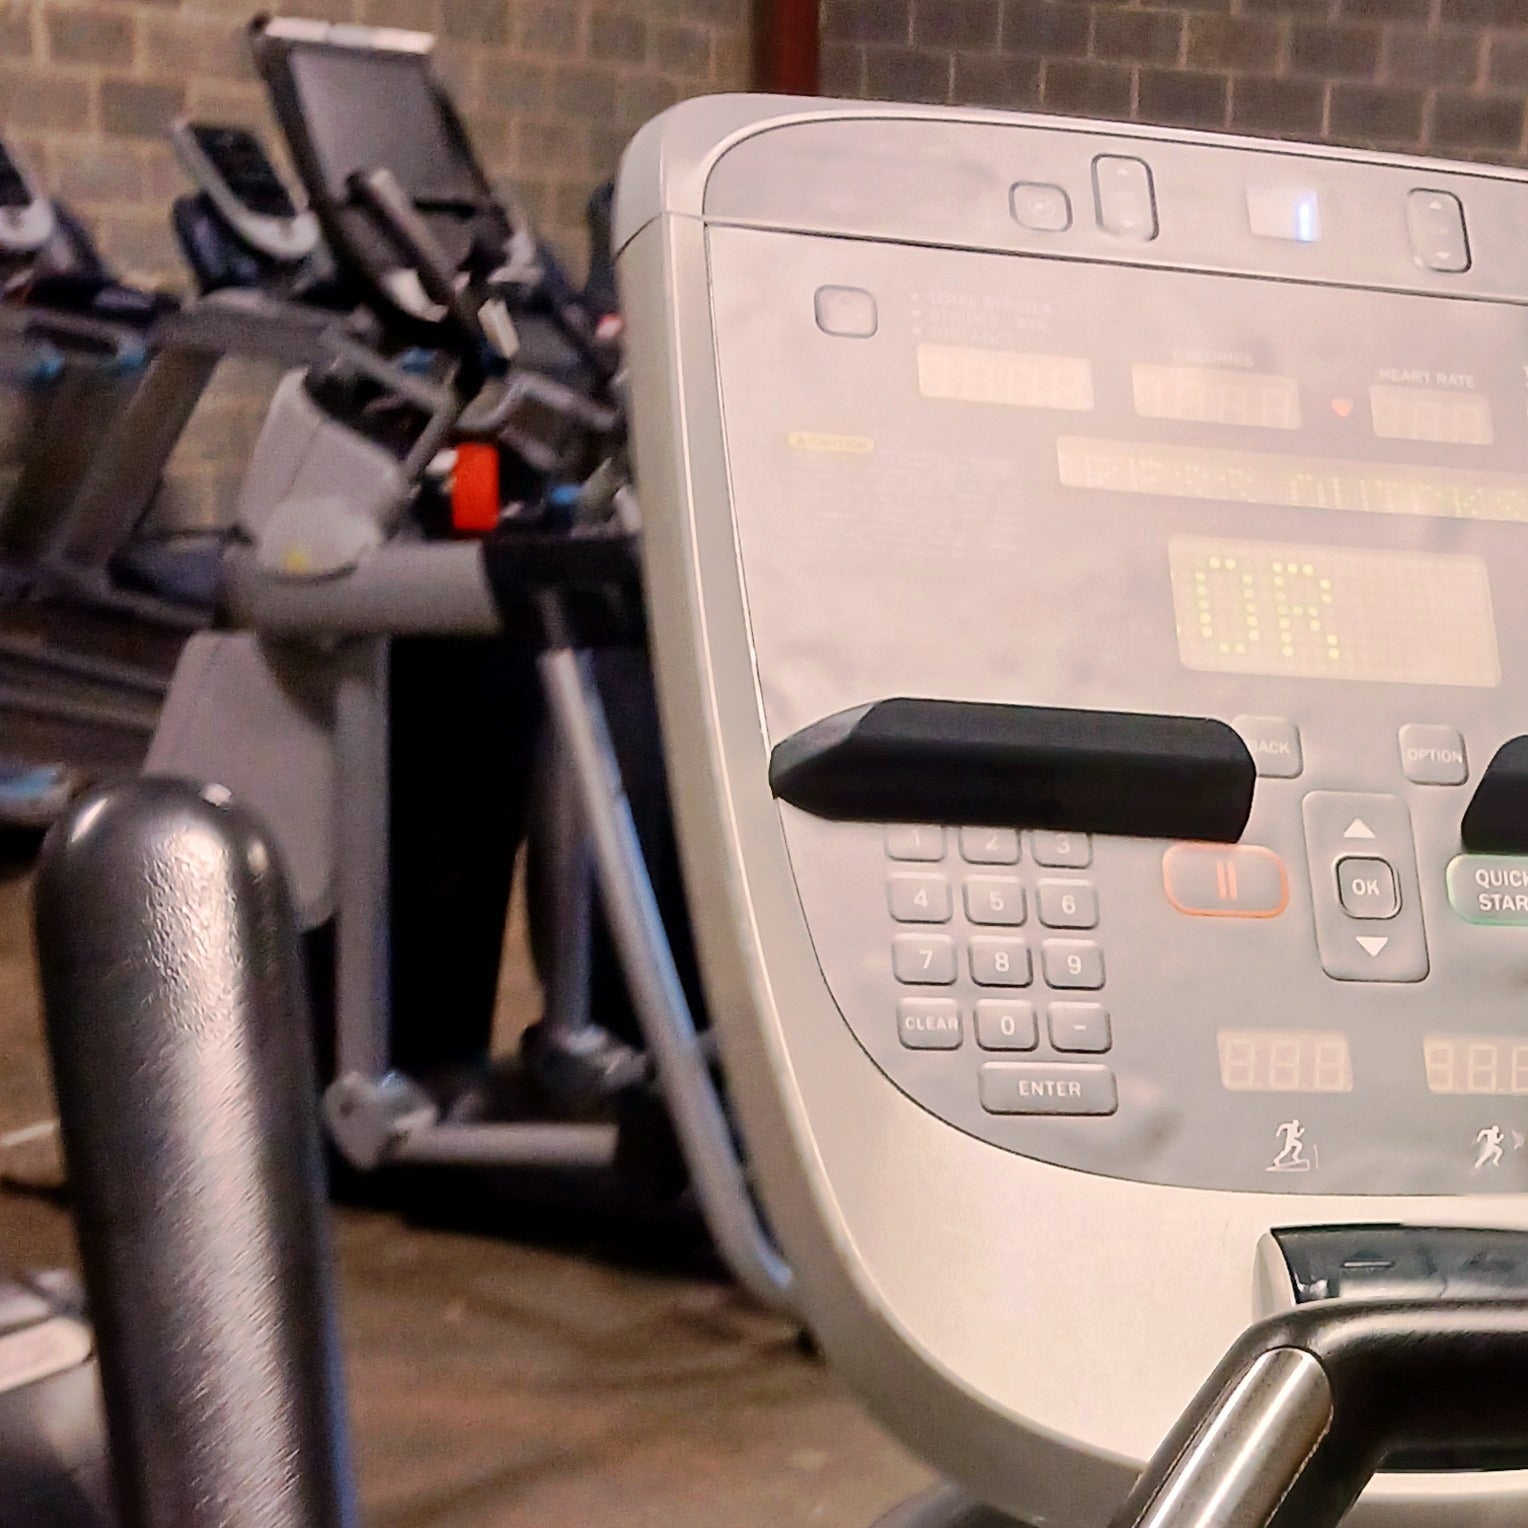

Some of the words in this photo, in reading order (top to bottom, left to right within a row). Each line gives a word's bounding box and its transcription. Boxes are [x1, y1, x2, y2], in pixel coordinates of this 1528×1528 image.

[1379, 367, 1431, 386] HEART
[1437, 371, 1475, 388] RATE
[1249, 739, 1290, 756] BACK
[1406, 748, 1463, 765] OPTION
[985, 831, 998, 851] 2
[1057, 833, 1071, 854] 3
[1351, 878, 1381, 897] OK
[913, 888, 929, 908] 4
[990, 891, 1005, 911] 5
[1061, 895, 1077, 915] 6
[919, 950, 933, 970] 7
[994, 952, 1010, 972] 8
[1067, 955, 1082, 975] 9
[905, 1016, 959, 1031] CLEAR
[1018, 1080, 1082, 1097] ENTER
